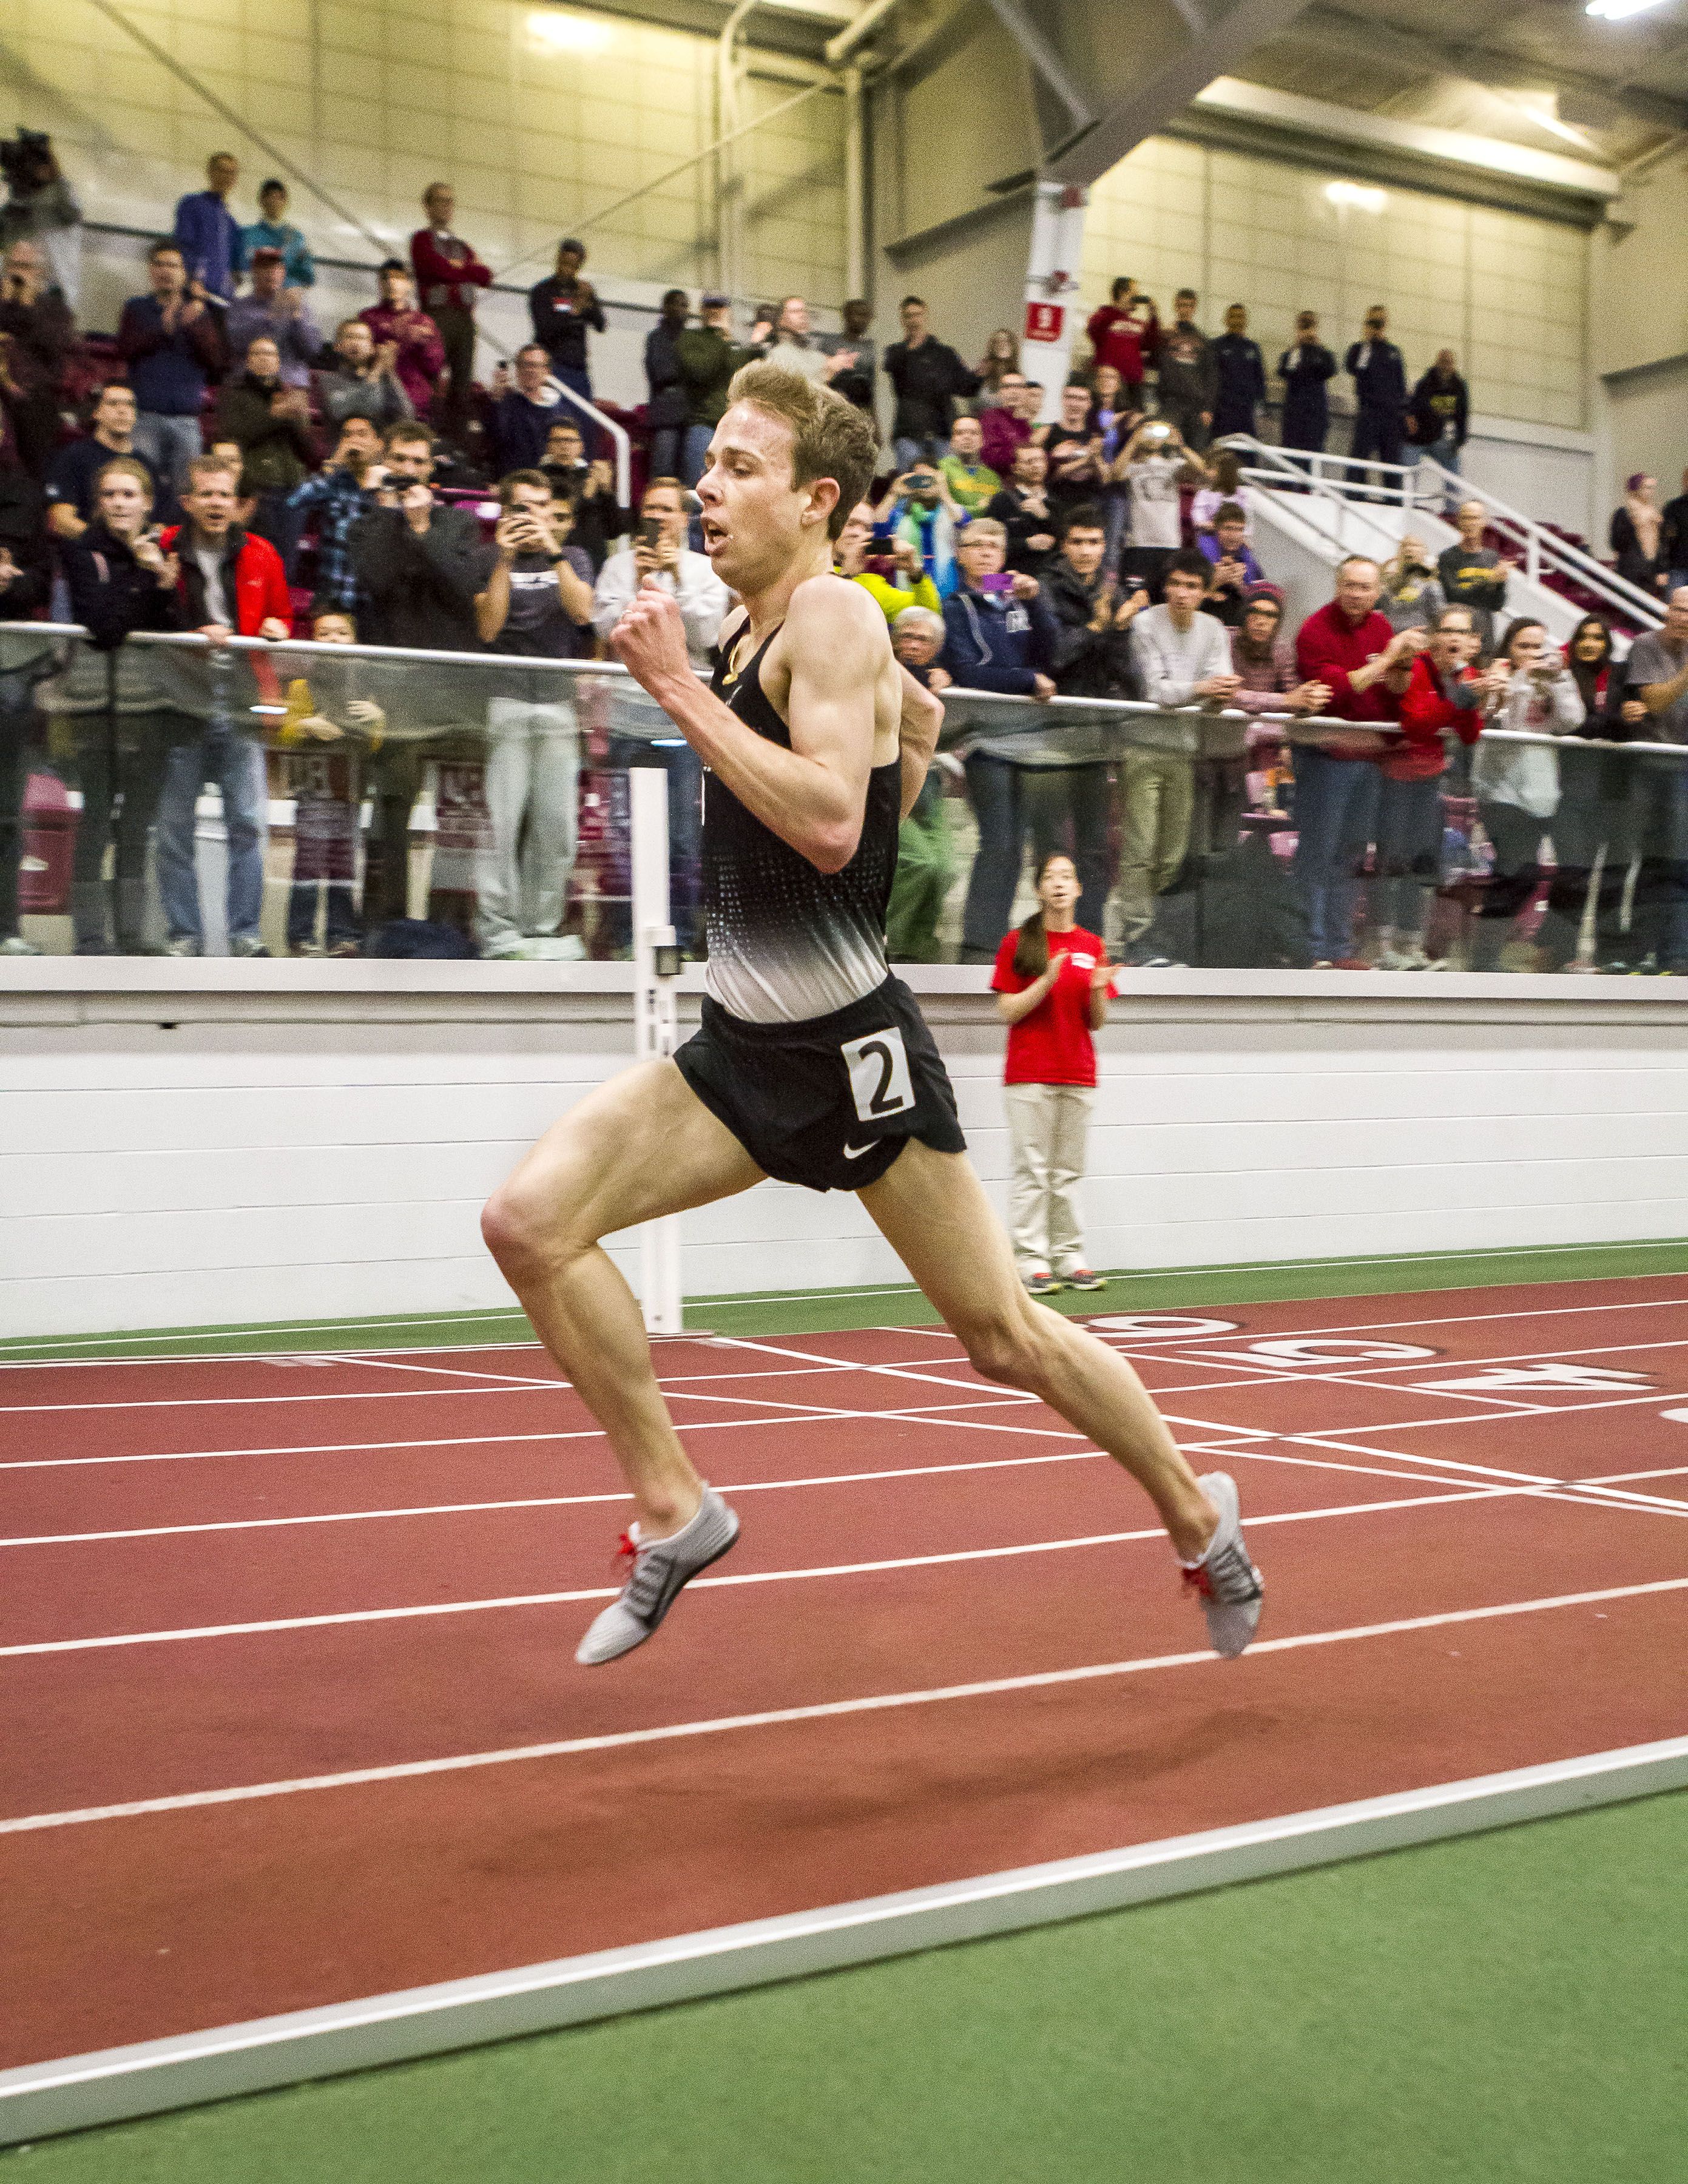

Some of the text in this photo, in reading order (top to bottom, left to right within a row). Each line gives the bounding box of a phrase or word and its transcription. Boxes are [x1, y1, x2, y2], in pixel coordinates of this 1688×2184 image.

[859, 1040, 903, 1114] 2
[1175, 1338, 1437, 1367] 5
[1408, 1363, 1660, 1390] 4
